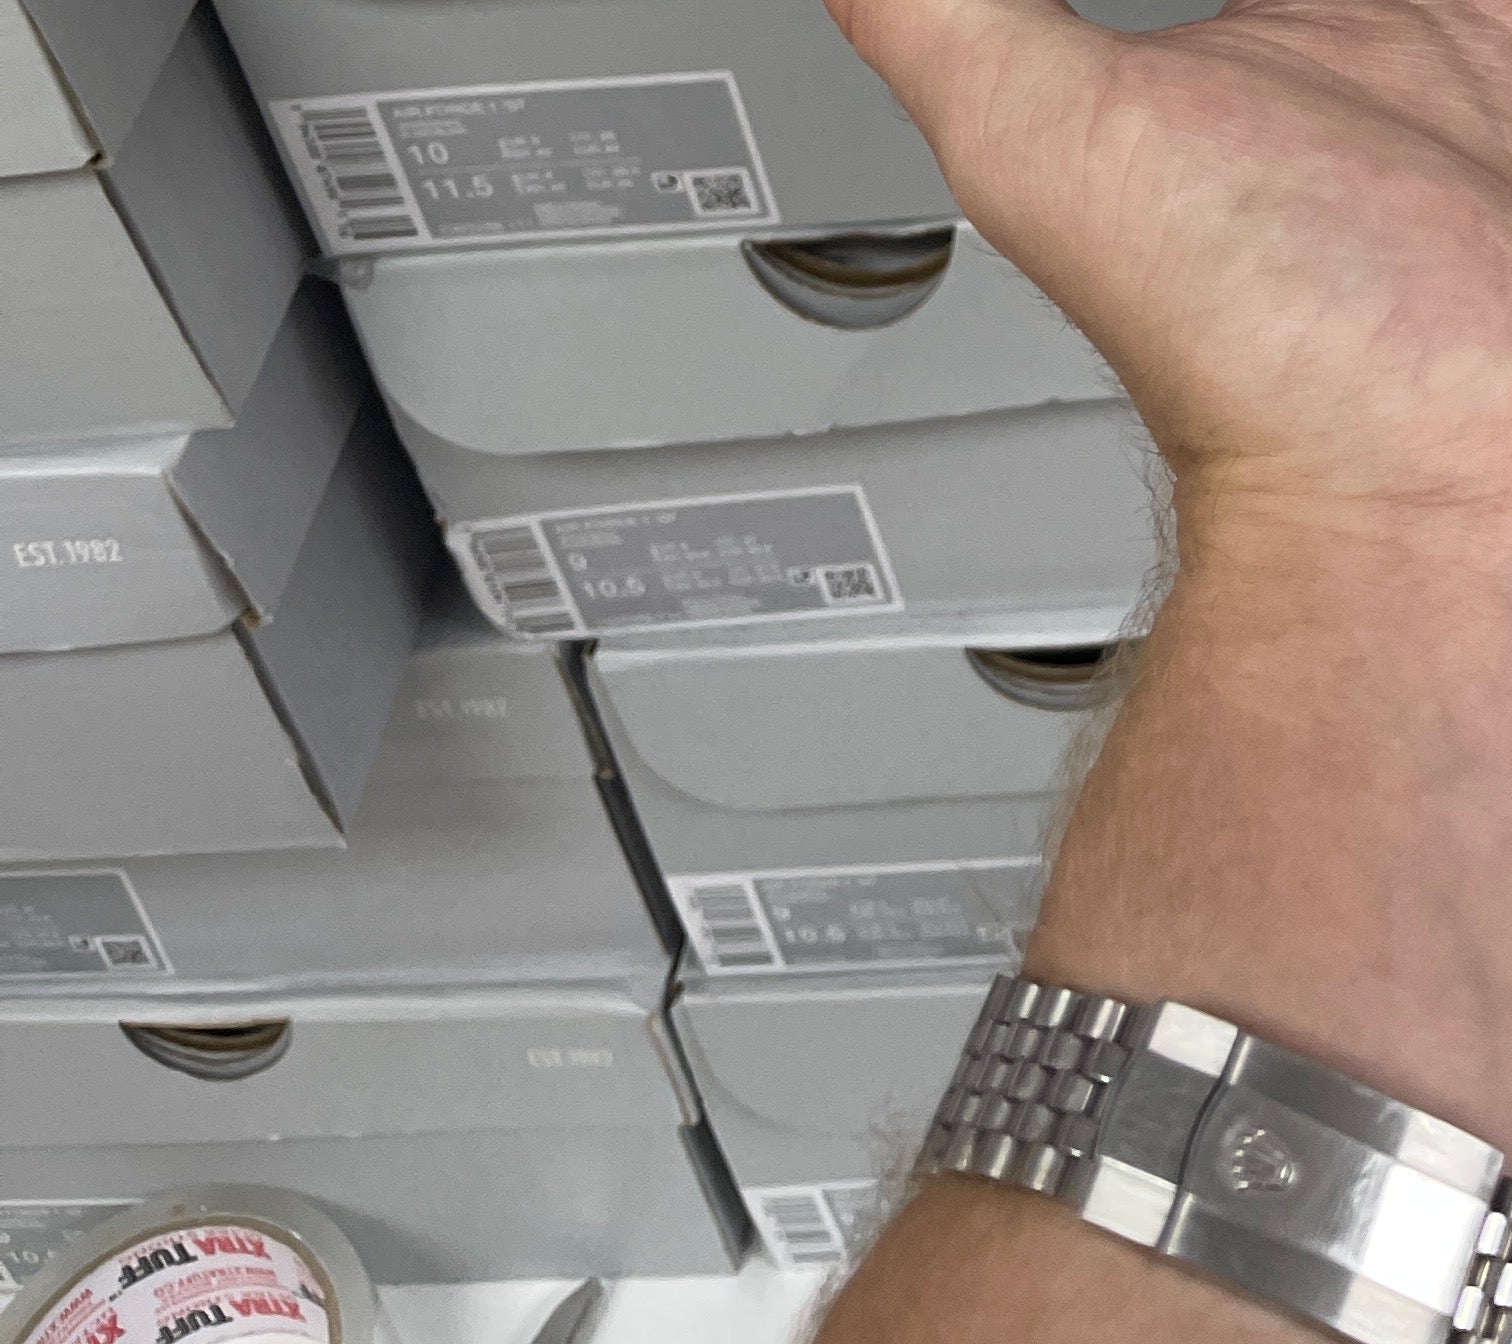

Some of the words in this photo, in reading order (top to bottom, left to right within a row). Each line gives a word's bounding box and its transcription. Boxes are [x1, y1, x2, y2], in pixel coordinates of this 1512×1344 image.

[408, 141, 449, 165] 10
[118, 1241, 199, 1290] TUFF
[156, 1304, 234, 1344] TUFF
